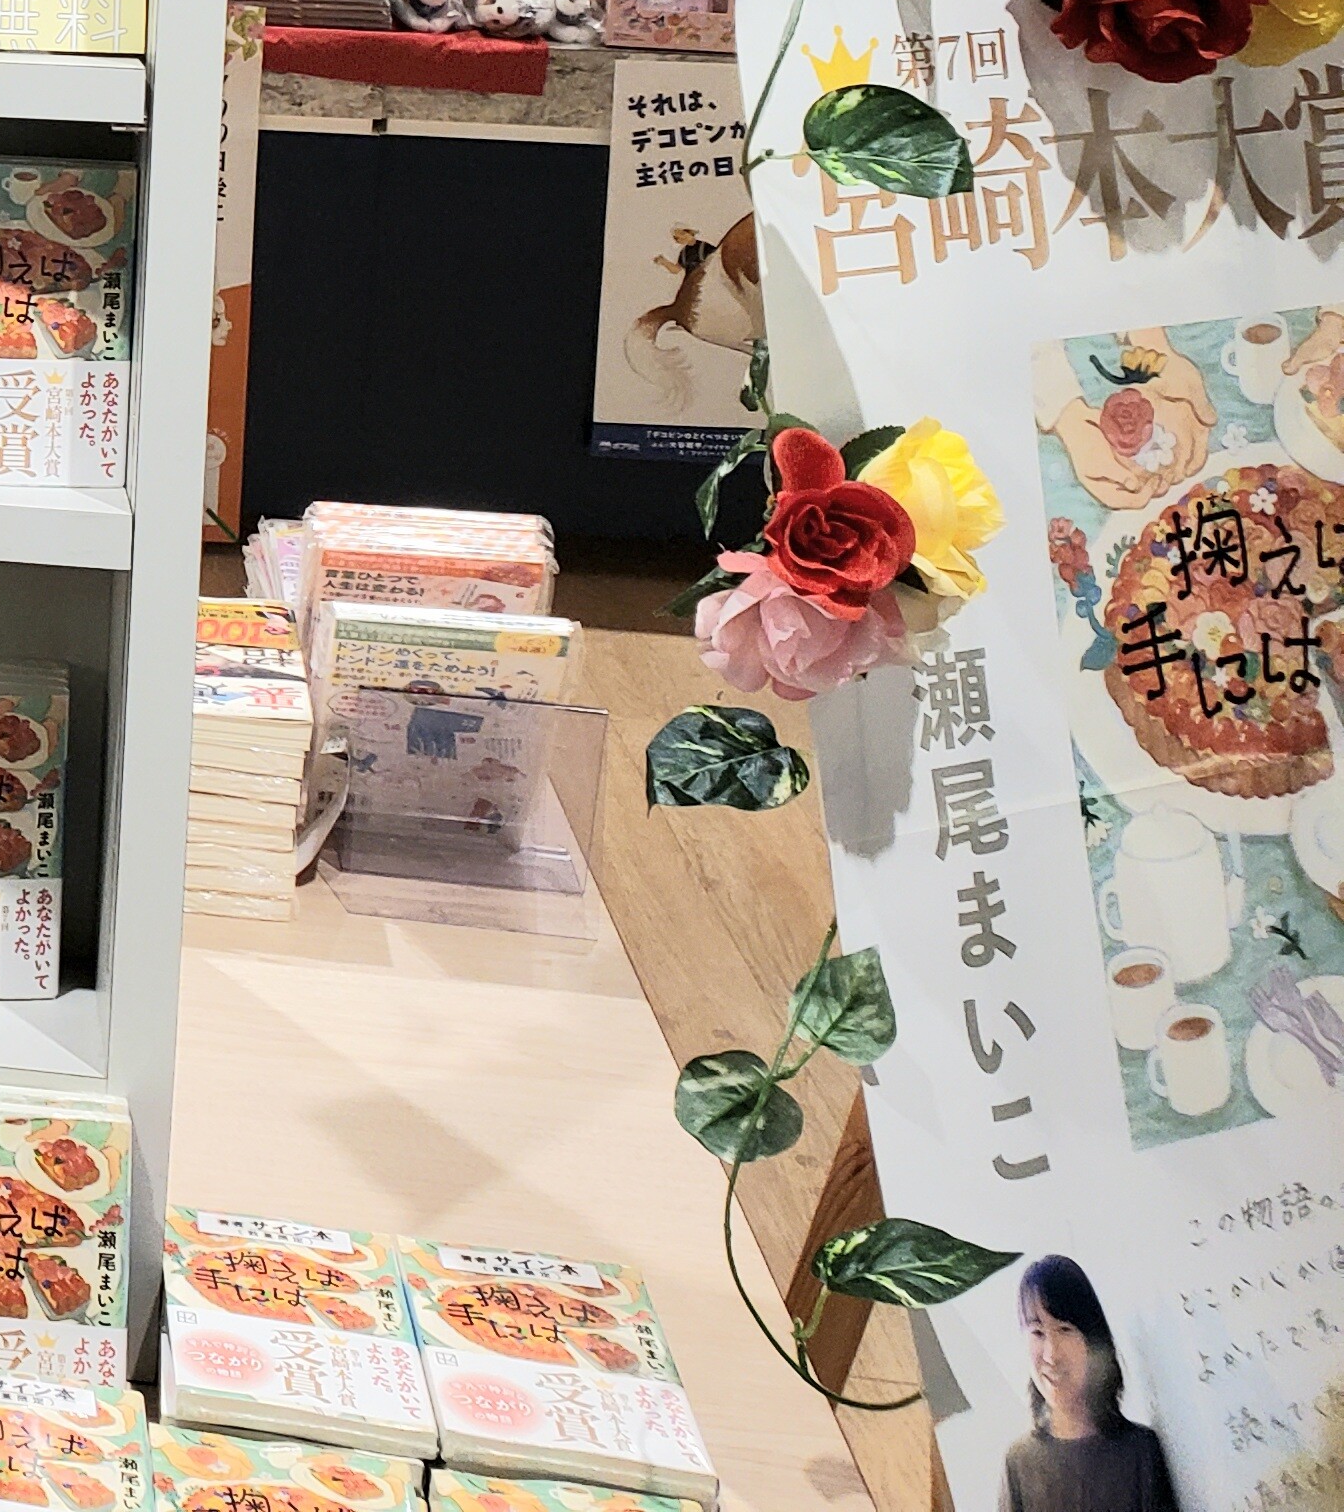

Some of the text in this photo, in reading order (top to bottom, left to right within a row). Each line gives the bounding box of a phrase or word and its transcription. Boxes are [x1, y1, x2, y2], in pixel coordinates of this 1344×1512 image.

[891, 27, 1010, 89] 第7回
[628, 90, 718, 119] それは、
[1123, 601, 1324, 718] 手には
[911, 646, 1052, 1182] 瀬尾まいこ
